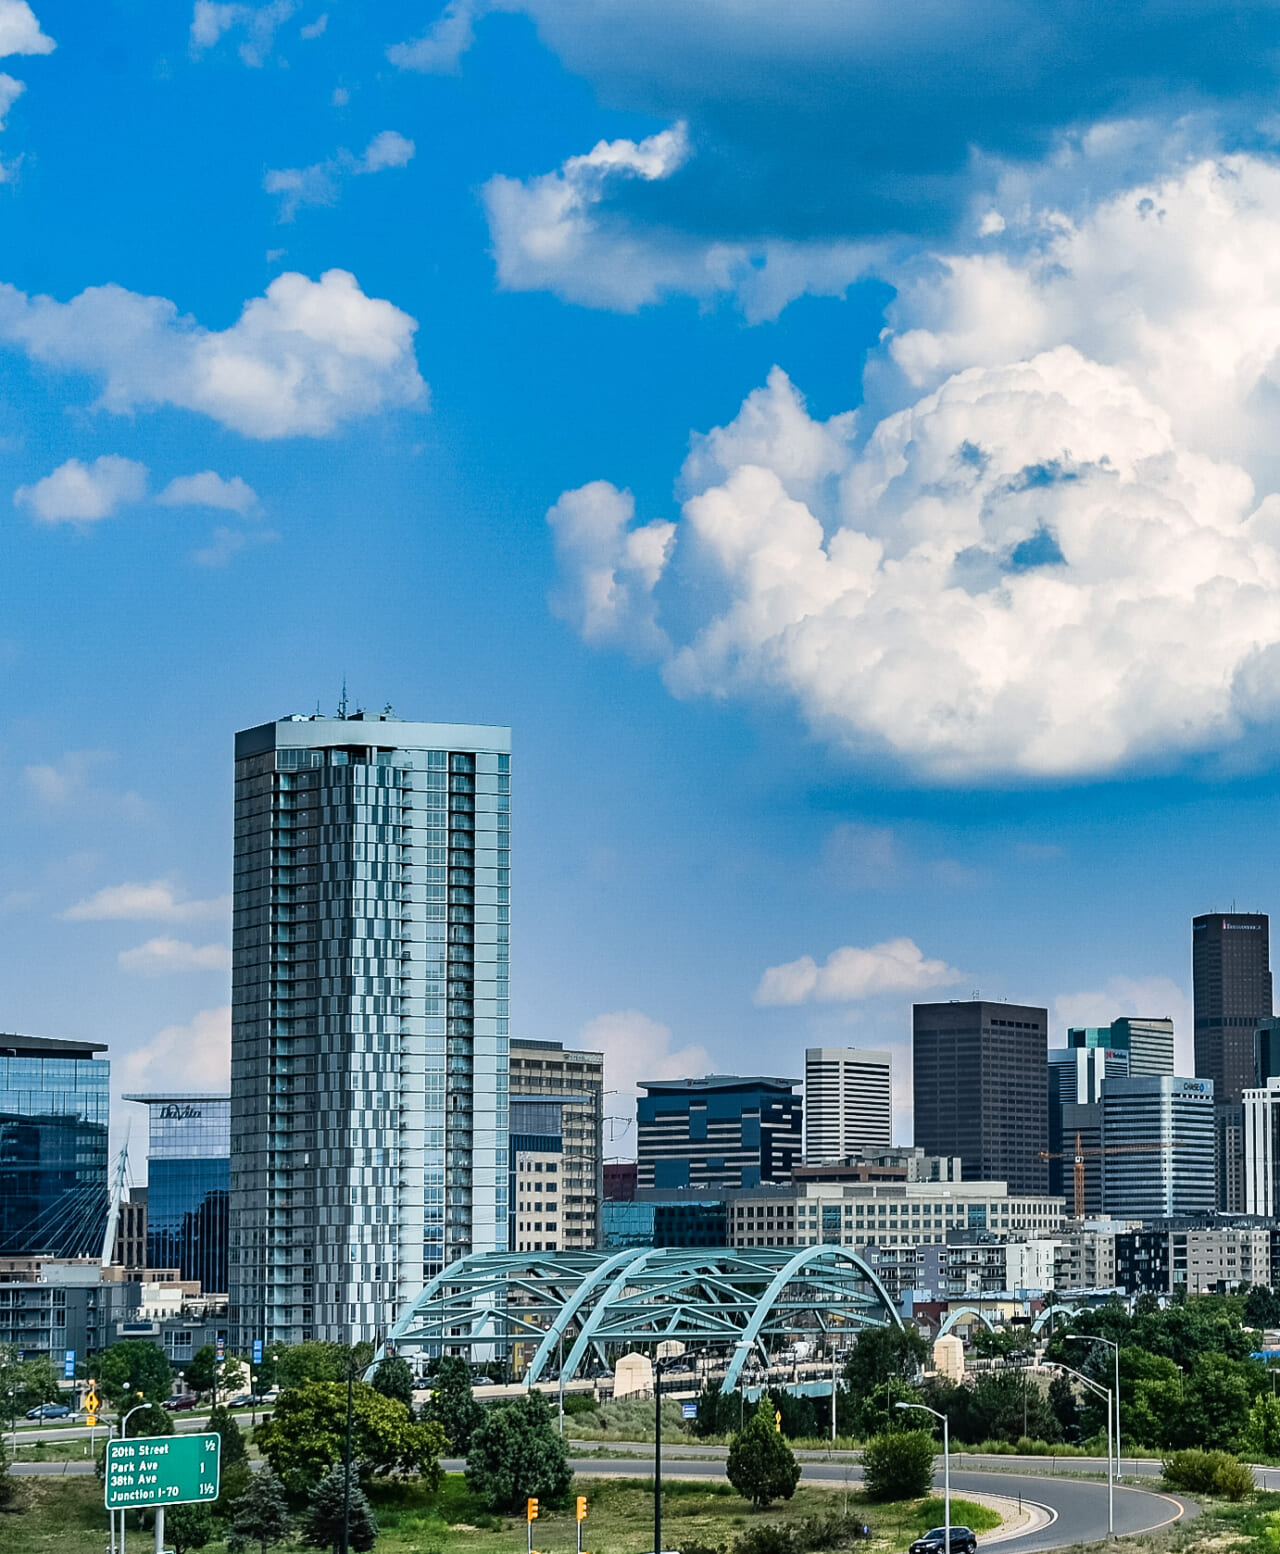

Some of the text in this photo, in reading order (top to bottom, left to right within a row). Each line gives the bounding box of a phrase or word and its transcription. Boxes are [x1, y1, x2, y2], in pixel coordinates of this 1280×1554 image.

[160, 1104, 202, 1121] DaVita
[112, 1446, 135, 1458] 20th
[139, 1444, 169, 1456] Street
[111, 1460, 205, 1473] Park Ave 1
[111, 1474, 157, 1487] 38th Ave
[110, 1489, 154, 1502] Junction
[158, 1486, 179, 1498] I-70
